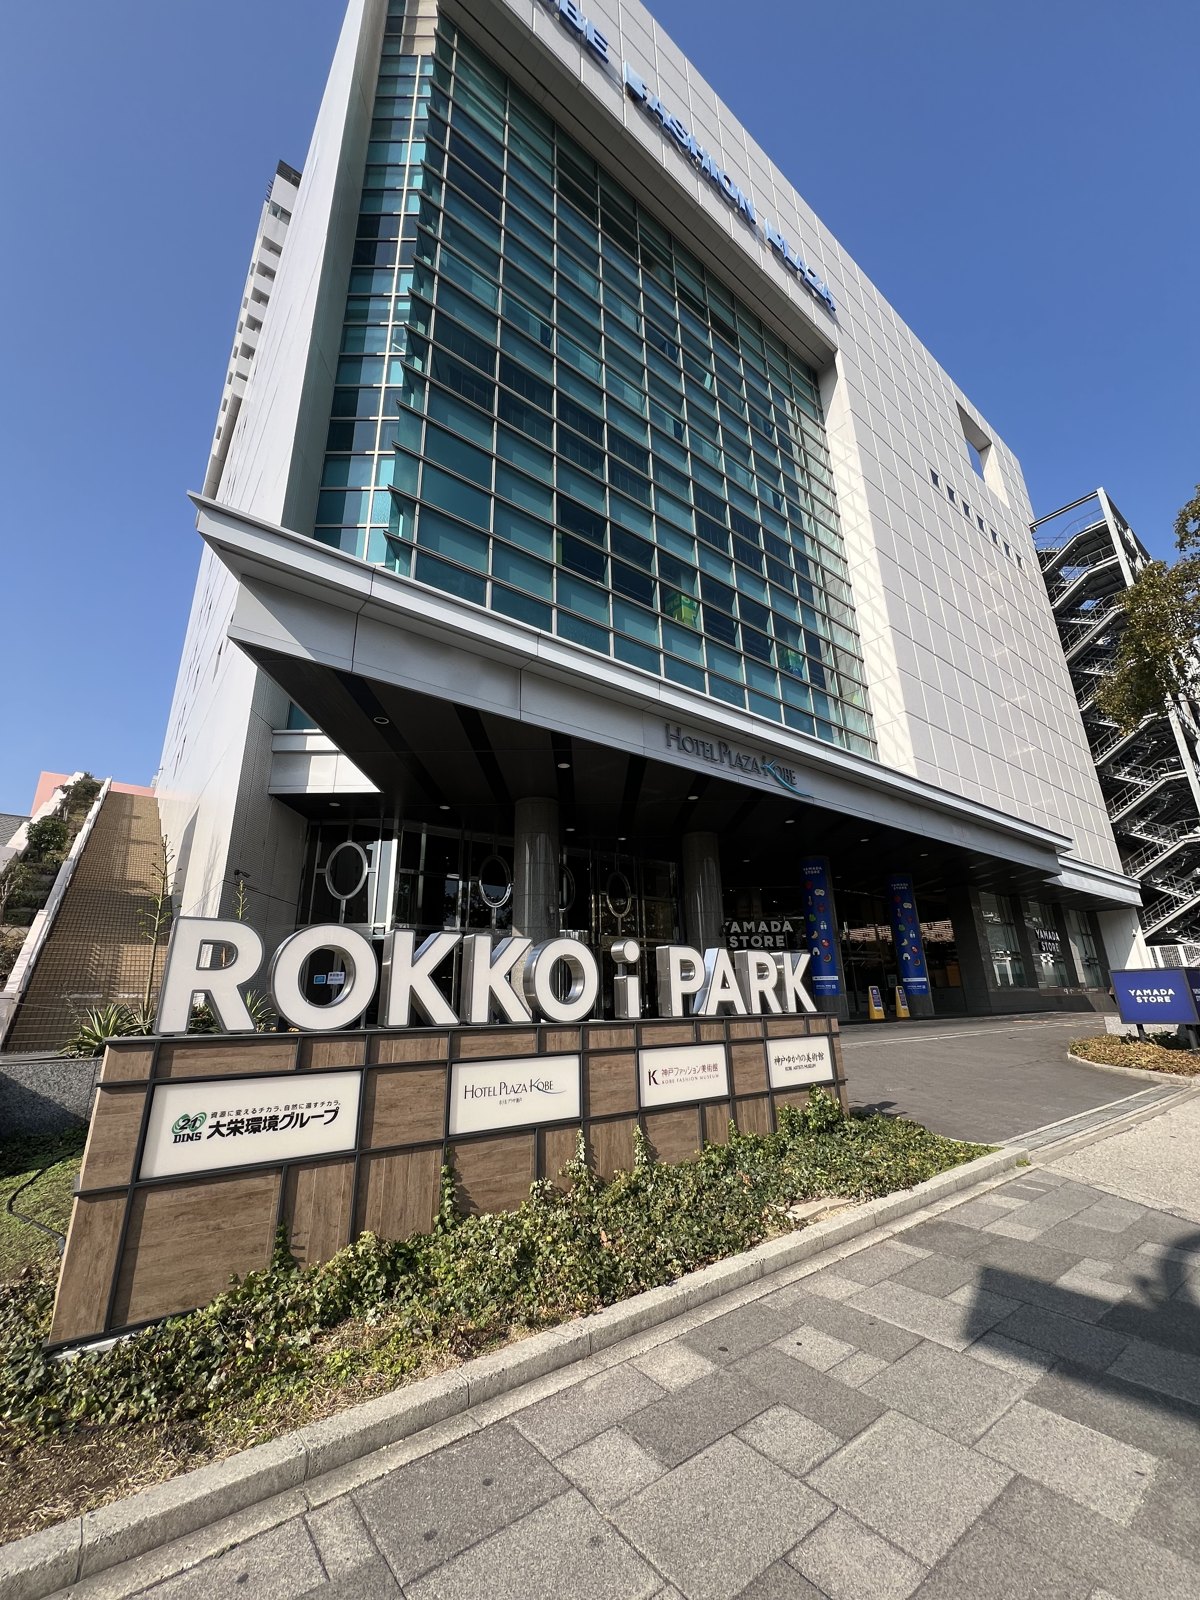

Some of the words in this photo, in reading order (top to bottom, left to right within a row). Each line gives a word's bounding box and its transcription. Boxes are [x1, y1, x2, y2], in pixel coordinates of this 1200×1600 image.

[547, 0, 610, 64] BE
[622, 60, 757, 225] FASHION
[763, 217, 836, 312] PLAZA
[665, 723, 718, 763] HOTEL
[718, 740, 763, 775] PLAZA
[761, 755, 808, 794] KOBE
[729, 935, 785, 948] STORE
[1035, 929, 1060, 941] YAMADA
[1041, 941, 1060, 952] STORE
[152, 916, 599, 1035] ROKKO
[611, 938, 641, 1019] i
[656, 944, 818, 1017] PARK
[1128, 988, 1175, 996] YAMADA
[661, 1063, 718, 1077] 神戸ファッション美術館
[464, 1085, 497, 1099] HOTEL
[499, 1081, 528, 1096] PLAZA
[529, 1077, 566, 1094] KOBE
[179, 1117, 198, 1130] 21
[207, 1106, 340, 1139] 大栄環境グループ
[173, 1132, 202, 1144] DINS
